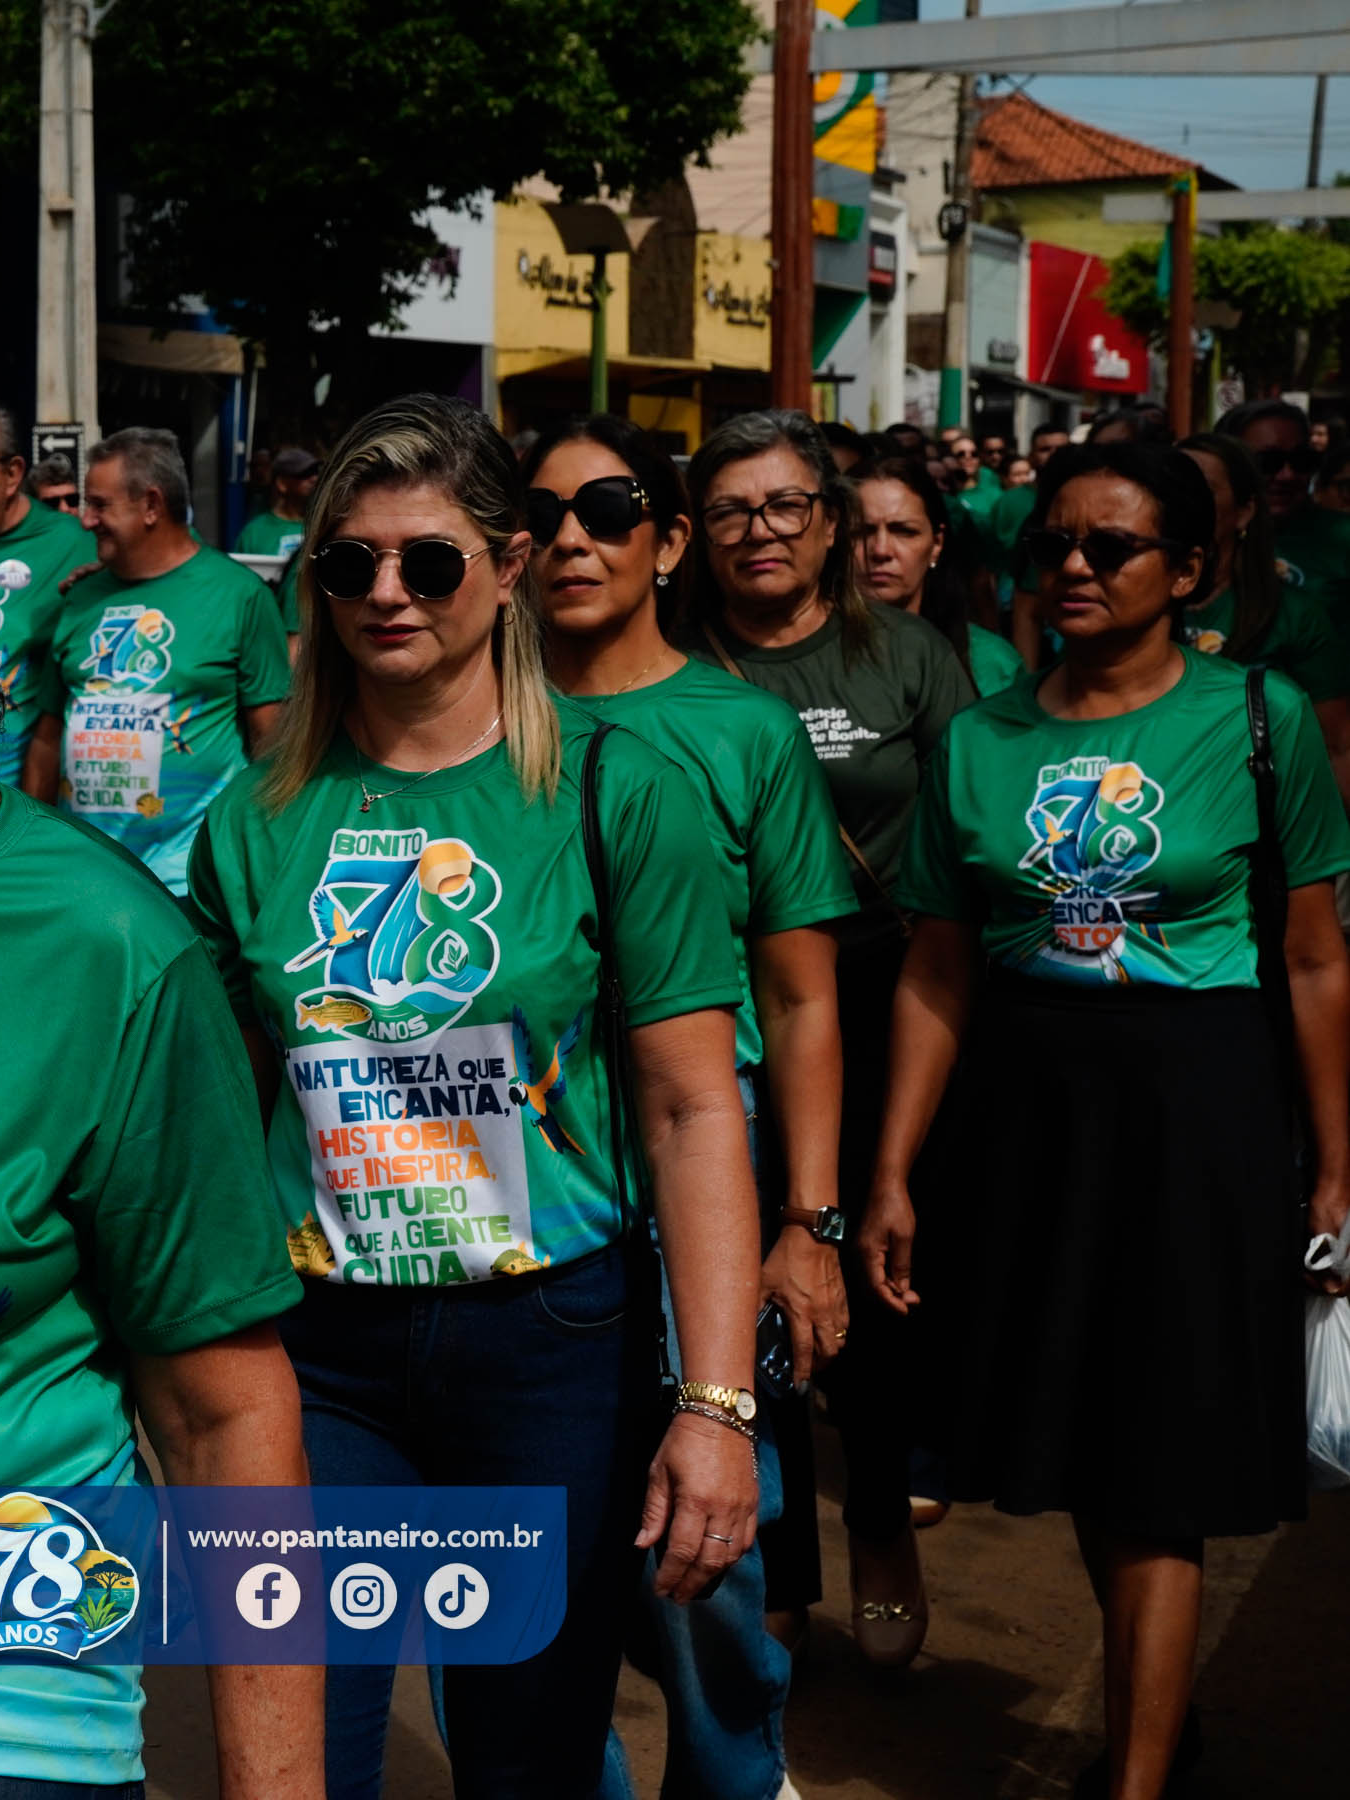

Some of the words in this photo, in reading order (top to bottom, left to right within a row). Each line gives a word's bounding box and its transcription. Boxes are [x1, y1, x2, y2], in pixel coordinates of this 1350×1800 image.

[1042, 759, 1107, 784] BONITO
[1034, 762, 1164, 884] 78
[334, 831, 423, 857] BONITO
[324, 840, 502, 1000] 78
[1052, 902, 1122, 924] ENCA
[367, 1013, 429, 1041] ANOS
[293, 1055, 450, 1092] NATUREZA
[459, 1058, 506, 1080] QUE
[339, 1084, 510, 1123] ENCANTA,
[325, 1167, 359, 1191] QUE
[364, 1151, 497, 1186] INSPIRA,
[336, 1185, 468, 1221] FUTURO
[345, 1231, 383, 1256] QUE
[392, 1232, 404, 1250] A
[406, 1214, 512, 1247] GENTE
